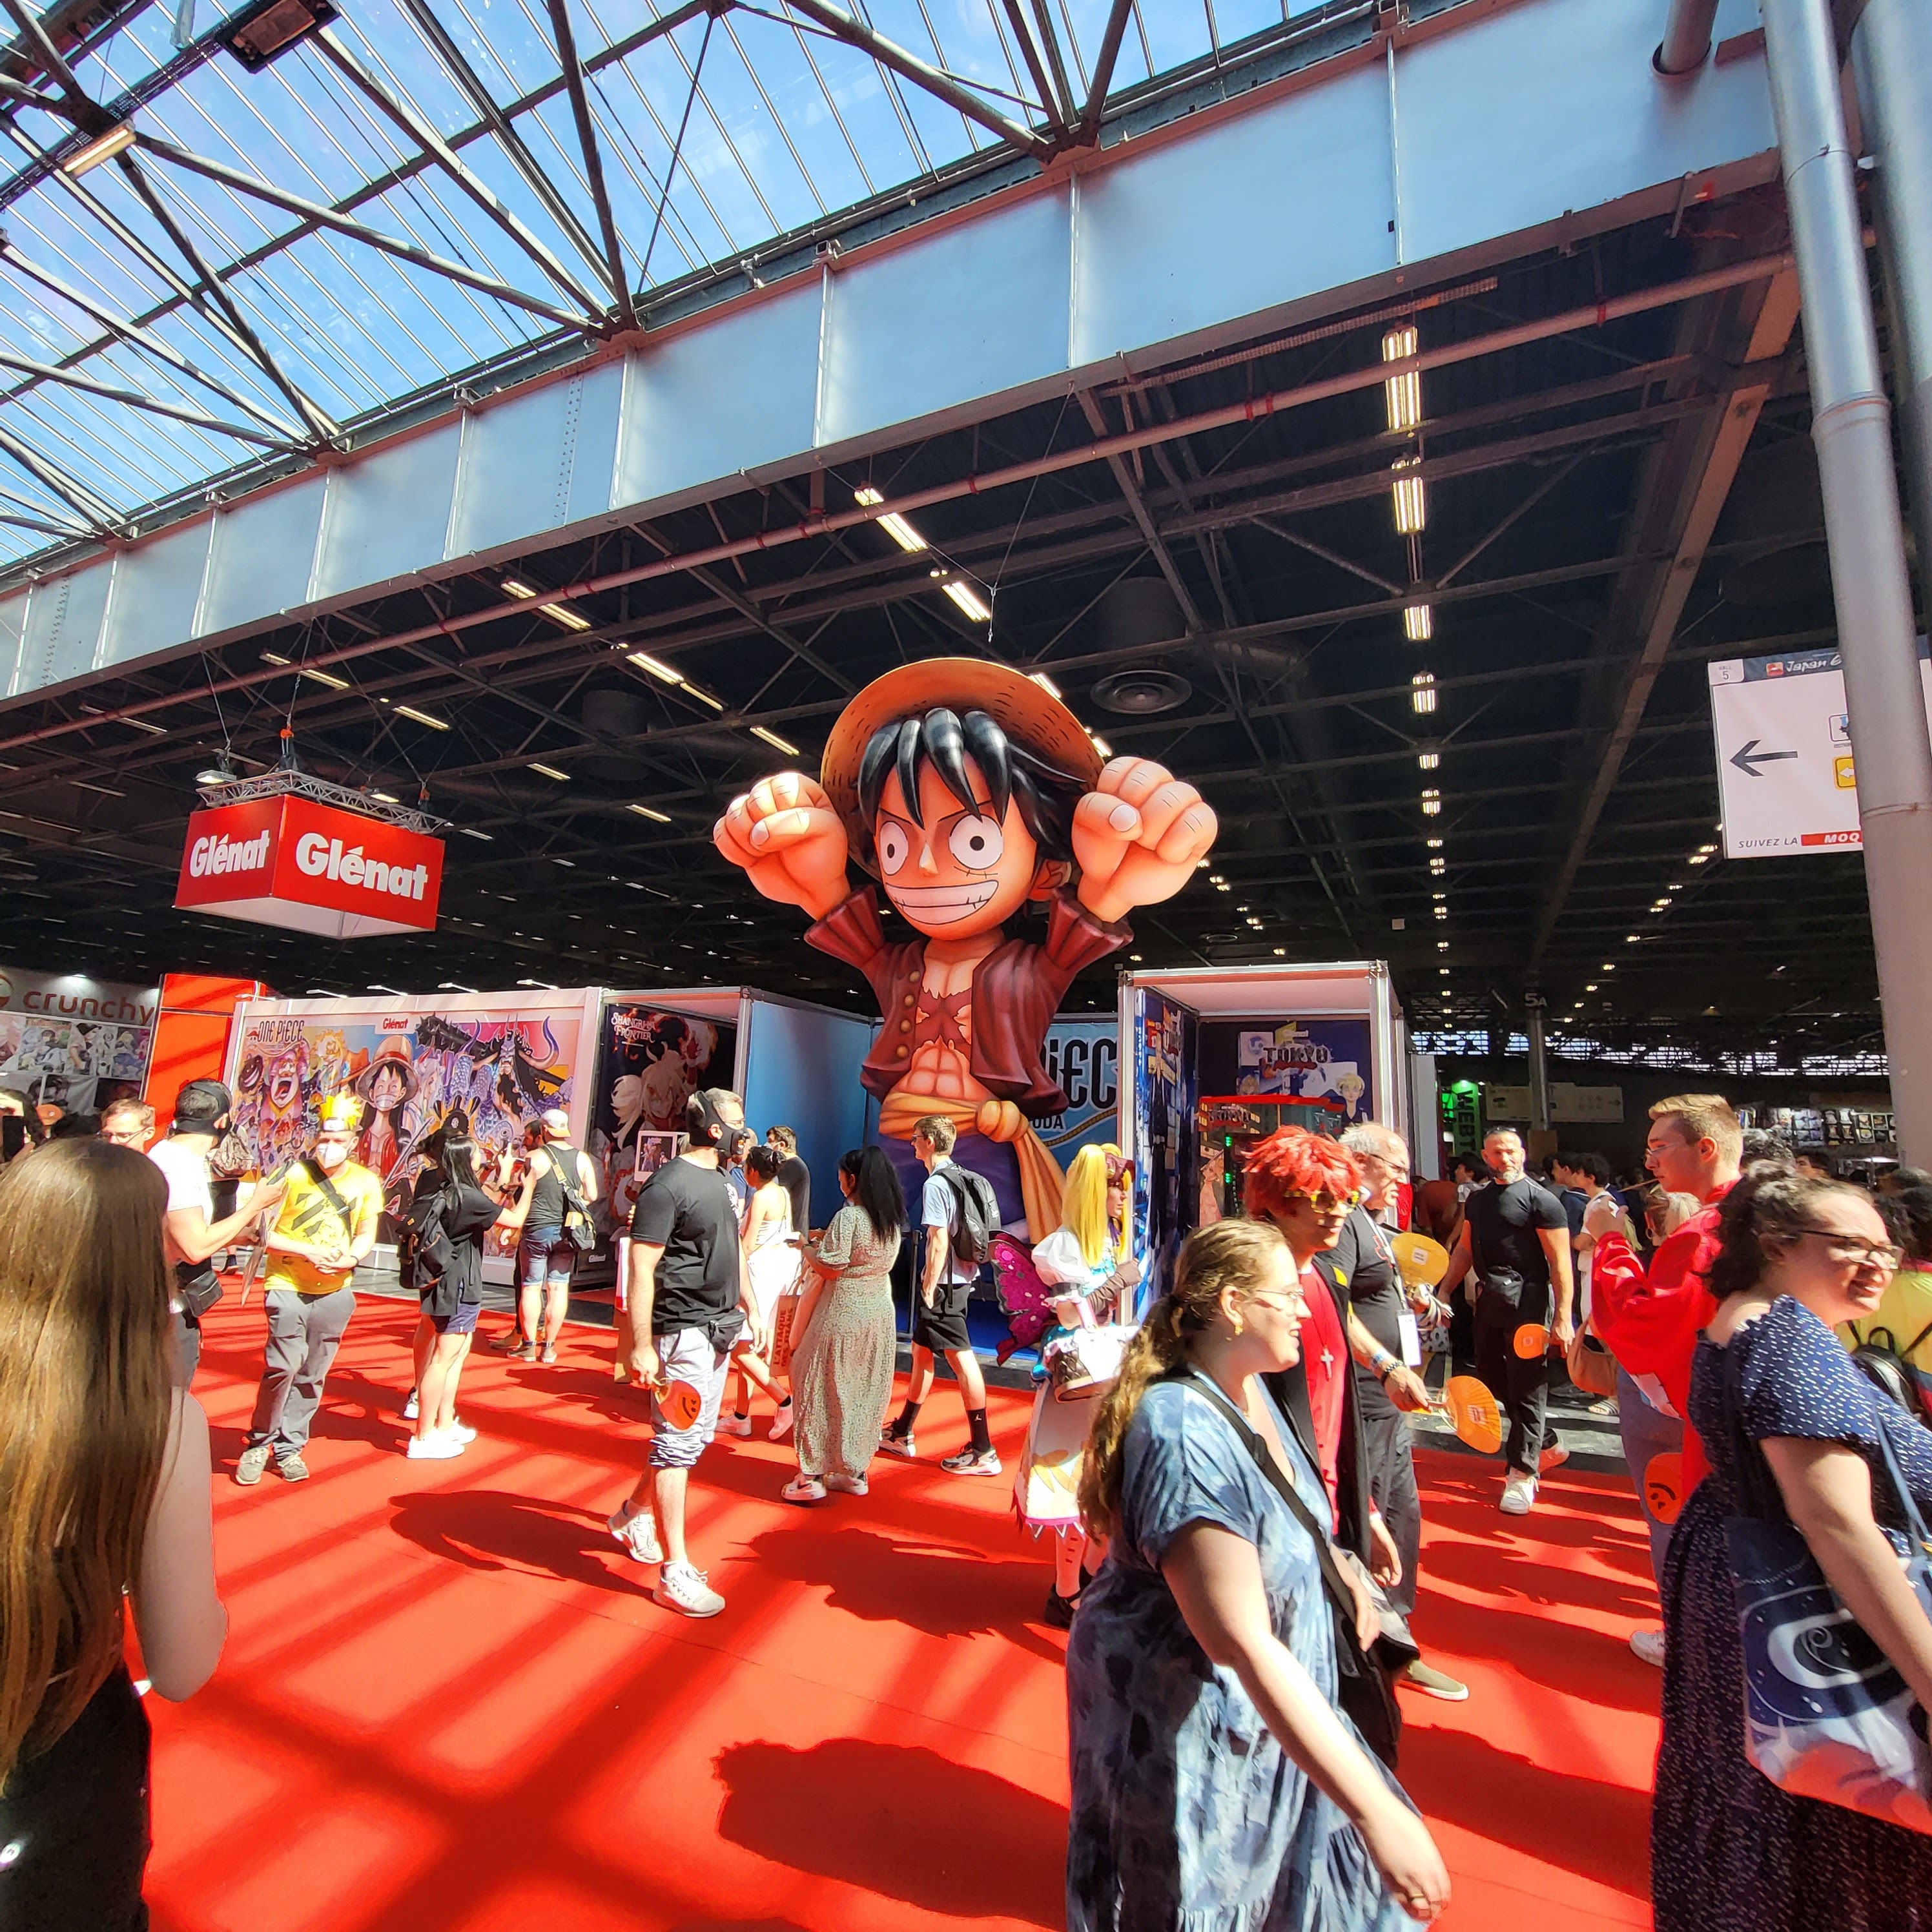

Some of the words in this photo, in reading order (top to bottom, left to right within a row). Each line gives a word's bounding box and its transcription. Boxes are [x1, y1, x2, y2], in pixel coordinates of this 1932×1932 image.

[1785, 659, 1826, 673] Japan
[1722, 670, 1729, 680] 5
[1738, 838, 1780, 848] SUIVEZ
[1784, 837, 1798, 845] LA
[190, 830, 270, 878] Glénat
[296, 832, 428, 901] Glénat
[23, 991, 155, 1025] crunchy
[382, 1017, 409, 1031] Glénat
[613, 1025, 655, 1043] FRONTIER
